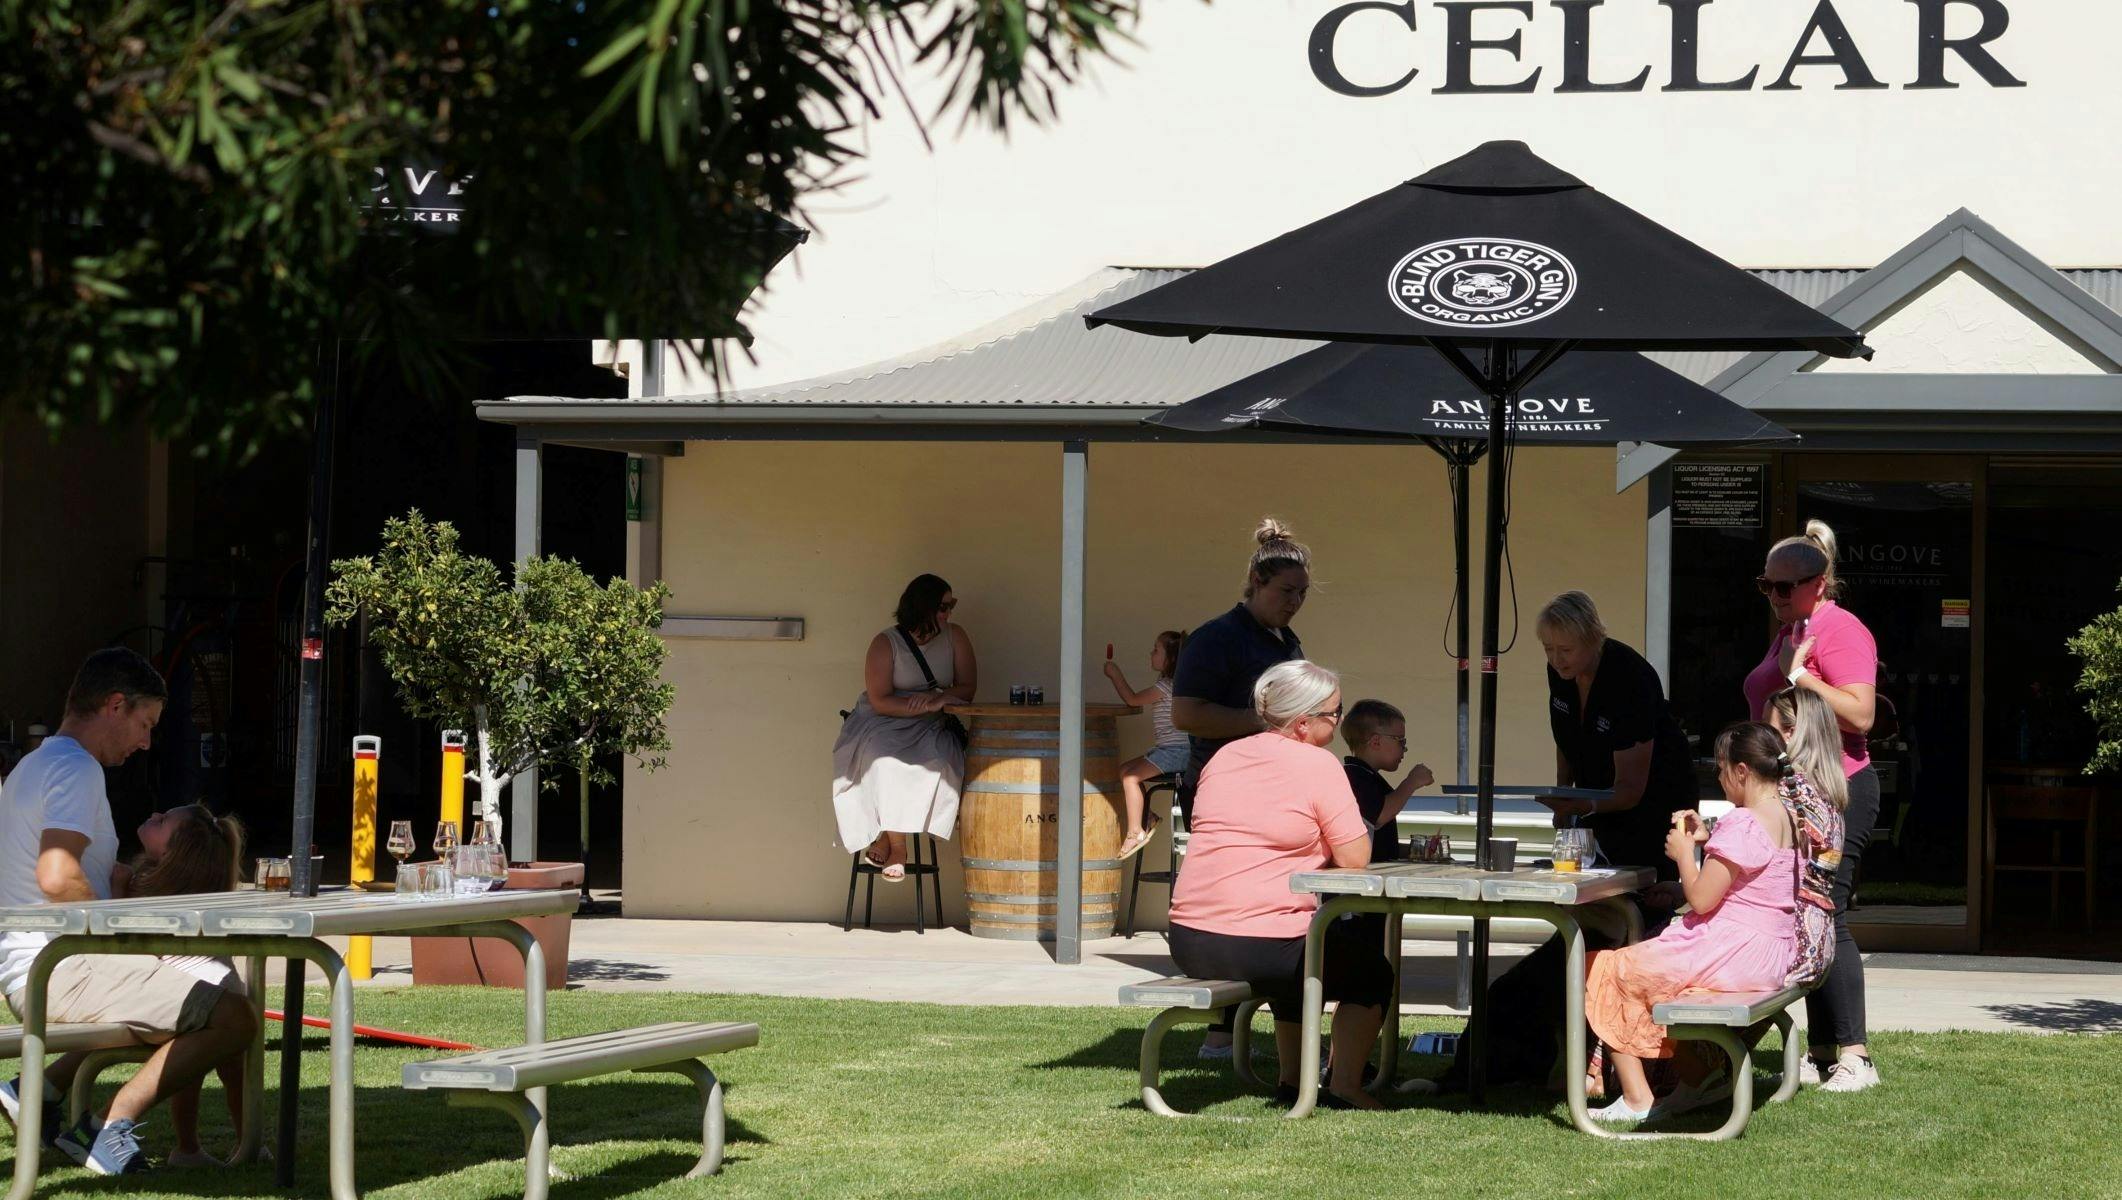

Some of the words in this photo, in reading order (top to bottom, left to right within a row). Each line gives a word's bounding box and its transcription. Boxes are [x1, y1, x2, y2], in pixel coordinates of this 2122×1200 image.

[1308, 0, 2027, 97] CELLAR
[1402, 249, 1456, 297] BLIND
[1459, 244, 1550, 271] TIGER
[1536, 269, 1564, 300] GIN
[1421, 303, 1534, 322] ORGANIC
[1434, 421, 1490, 430] FAMILY
